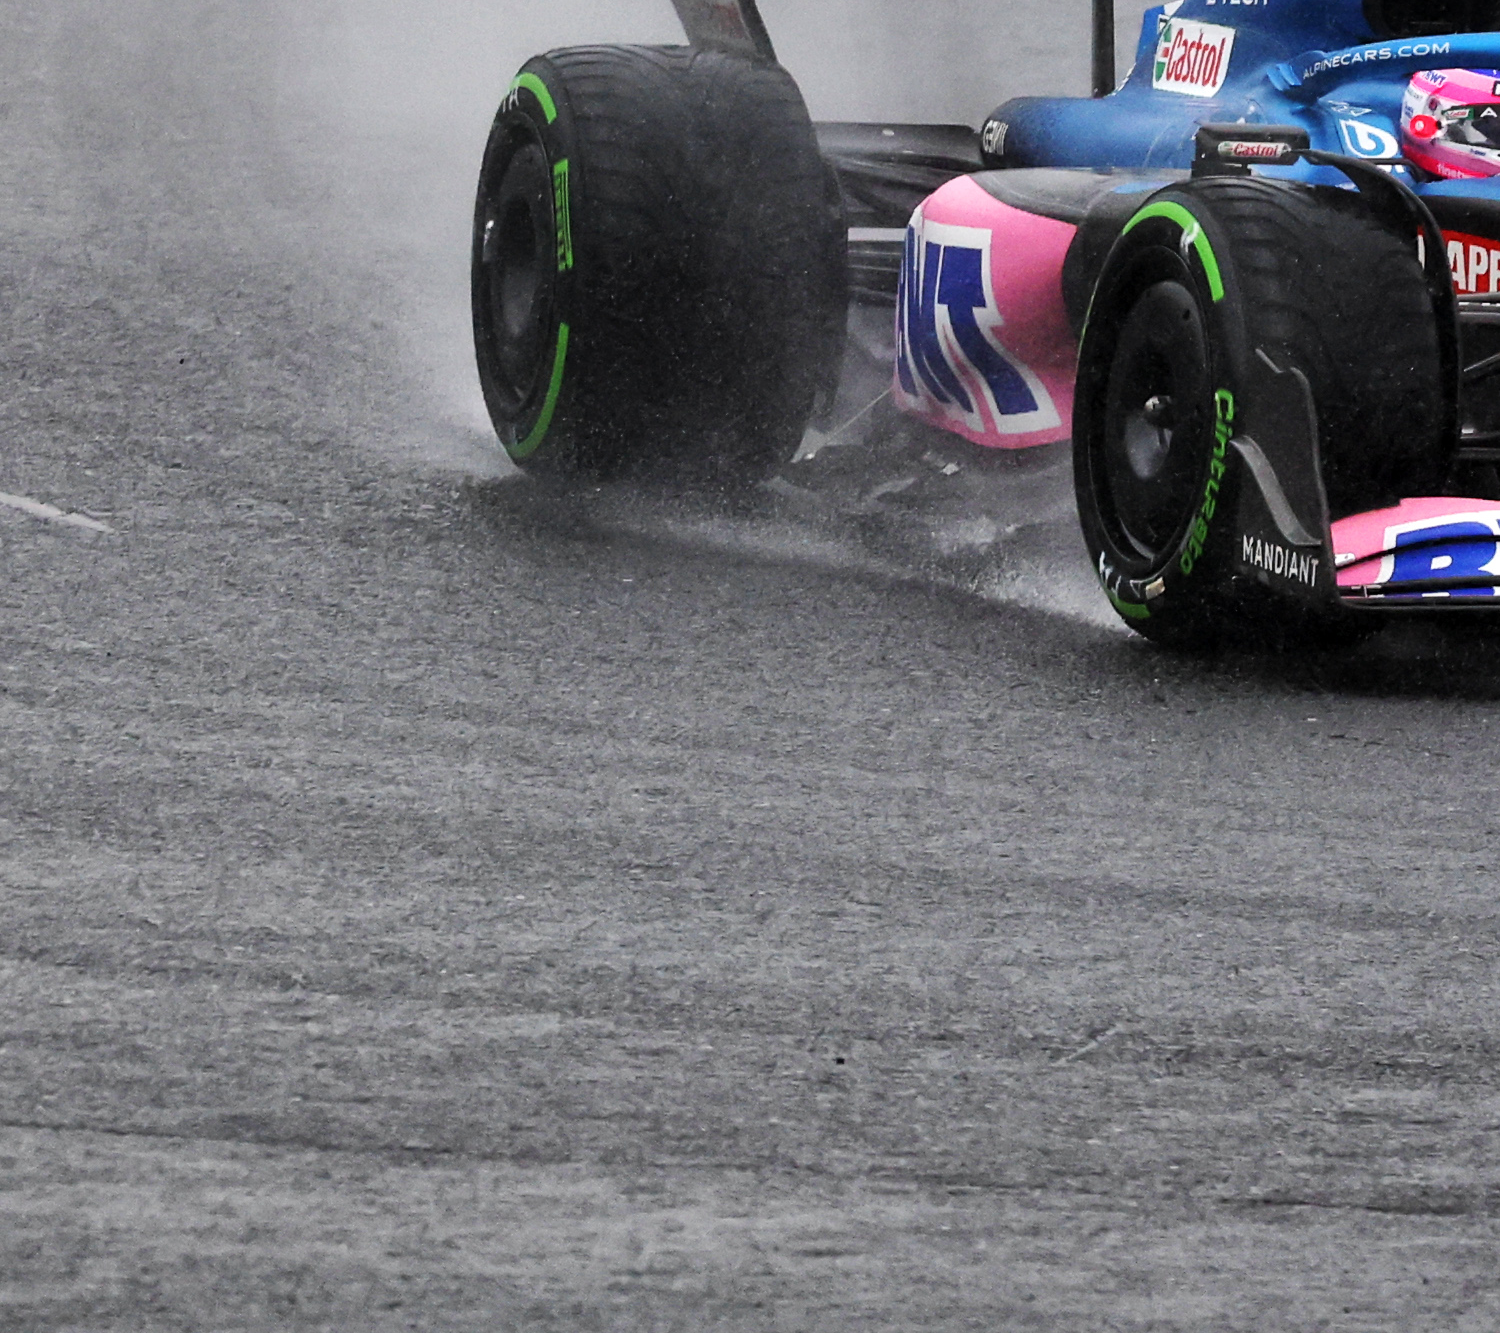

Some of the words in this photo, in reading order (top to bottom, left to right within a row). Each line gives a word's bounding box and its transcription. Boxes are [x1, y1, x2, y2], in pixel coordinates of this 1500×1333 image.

[1166, 27, 1227, 88] Castrol
[1303, 42, 1450, 80] ALPINECARS.COM
[1242, 534, 1320, 587] MANDIANT
